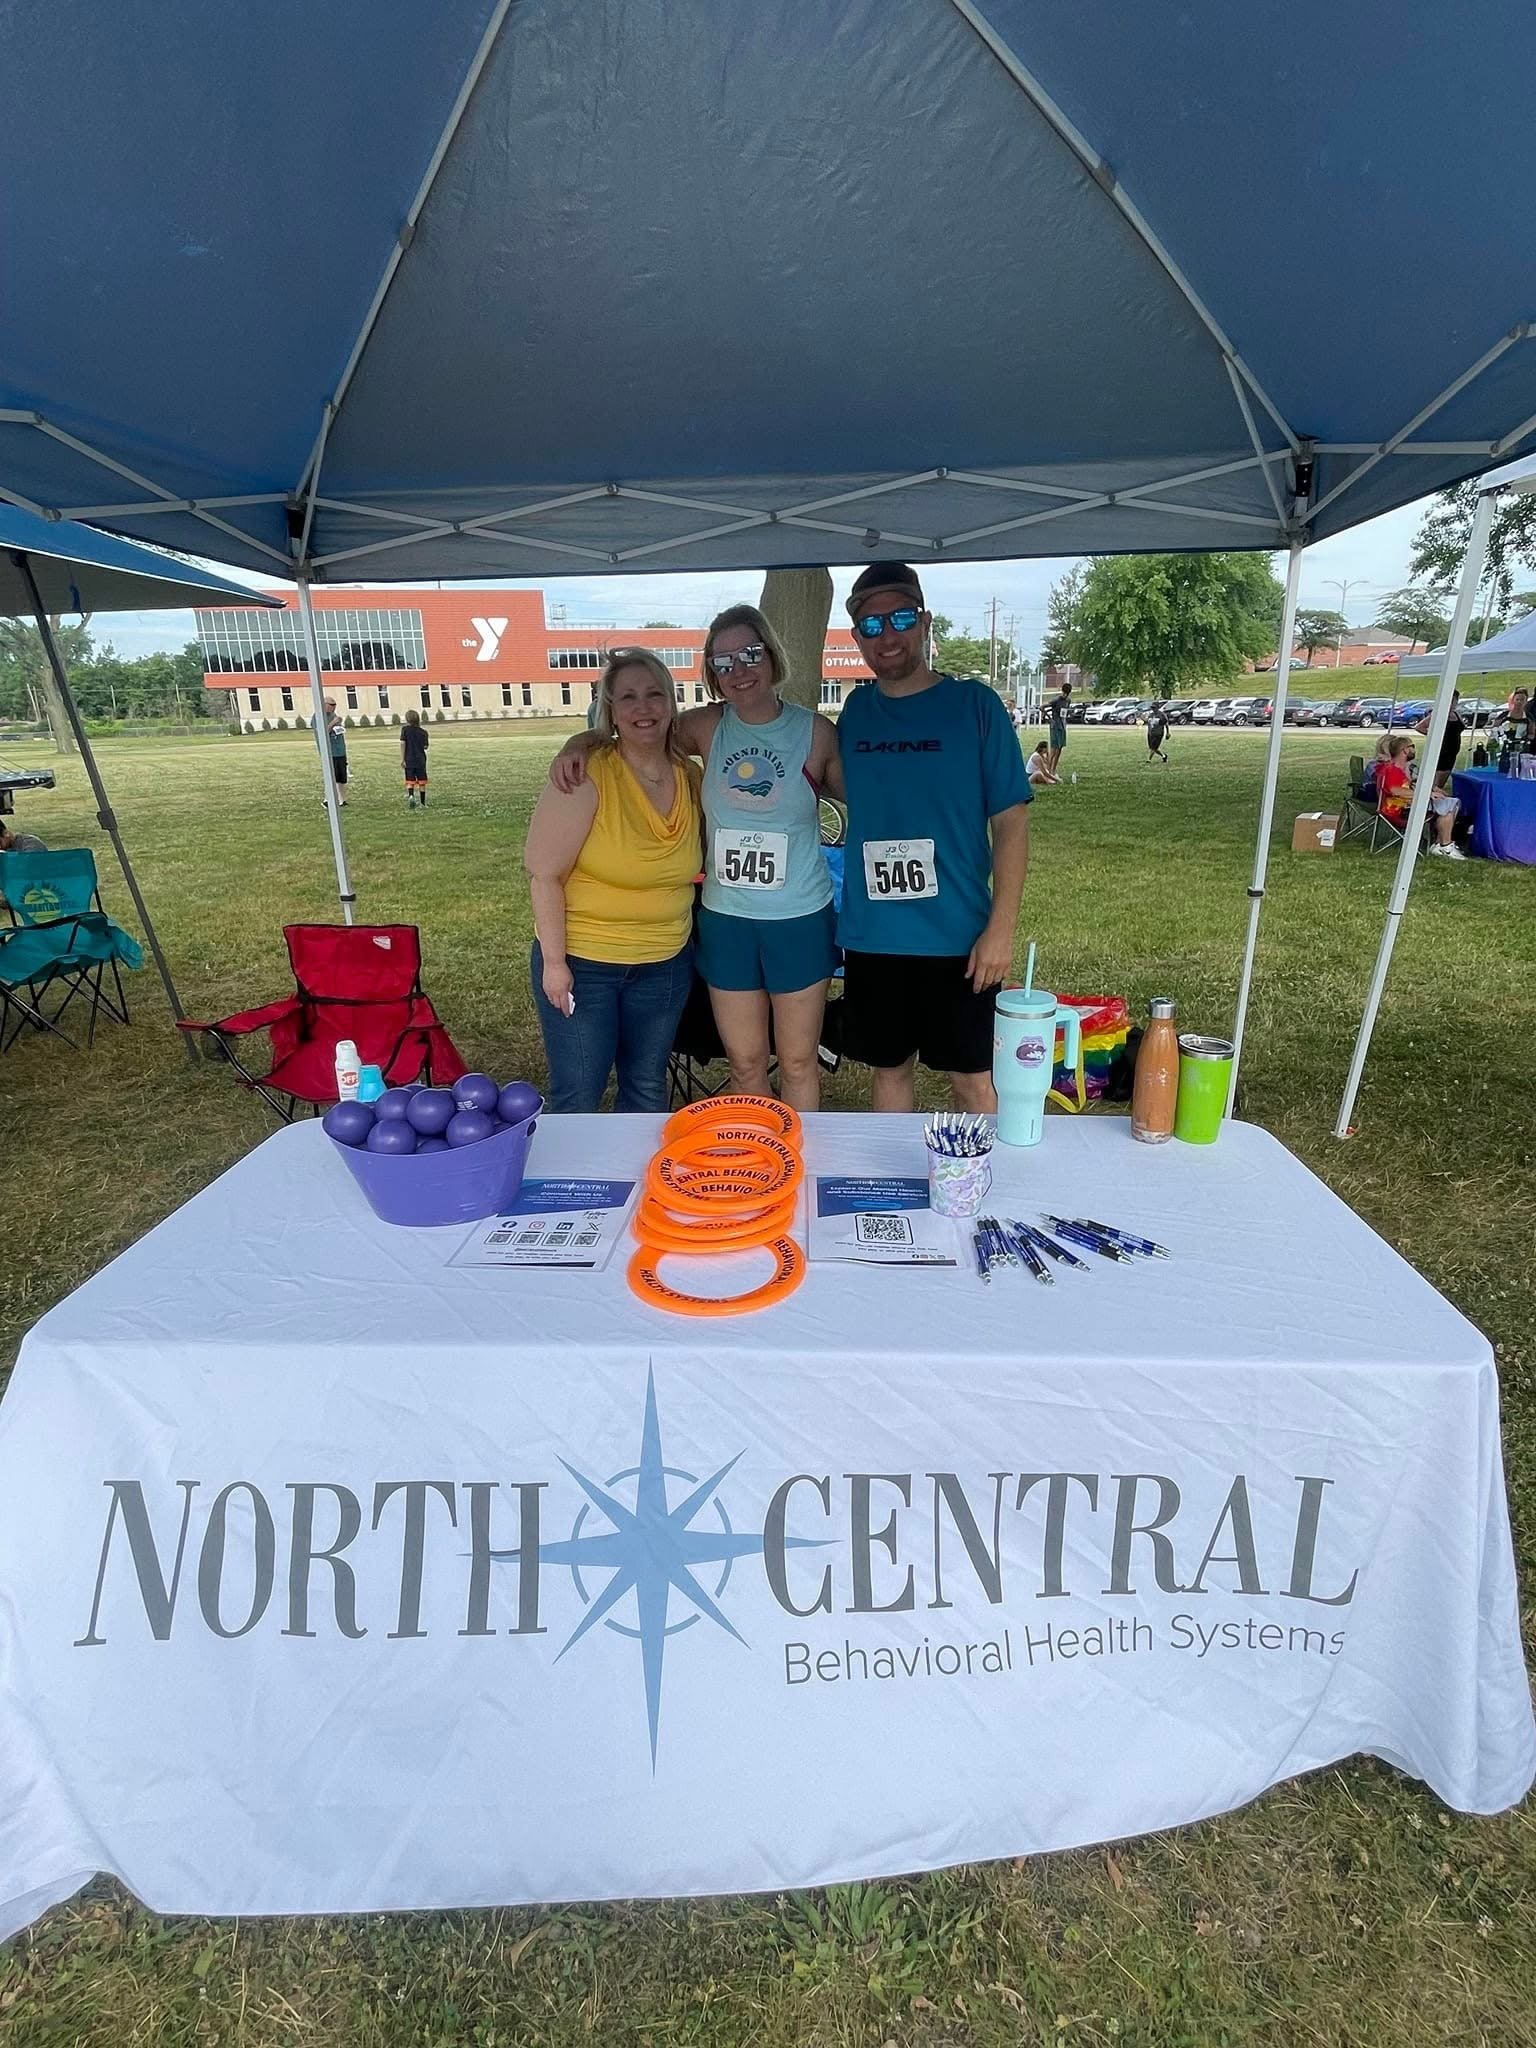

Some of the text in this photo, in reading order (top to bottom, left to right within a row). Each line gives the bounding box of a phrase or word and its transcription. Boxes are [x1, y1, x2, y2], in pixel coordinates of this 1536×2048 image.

[462, 639, 477, 647] the
[825, 657, 865, 667] OTTAWA
[855, 740, 942, 752] DAKINE
[762, 749, 785, 778] MIND
[725, 849, 775, 884] 545
[874, 859, 926, 894] 546
[688, 1099, 721, 1115] NORTH
[723, 1097, 767, 1108] CENTRAL
[717, 1132, 756, 1142] NORTH
[757, 1136, 792, 1160] CENTRAL
[677, 1169, 770, 1184] ENTRAL BEHAVIO
[702, 1184, 752, 1194] BEHAVIO
[771, 1239, 795, 1286] BEHAVIORAL
[640, 1268, 667, 1294] HEALTH
[73, 1473, 1360, 1648] NORTH CENTRAL
[785, 1614, 1345, 1684] Behavioral Health Systems
